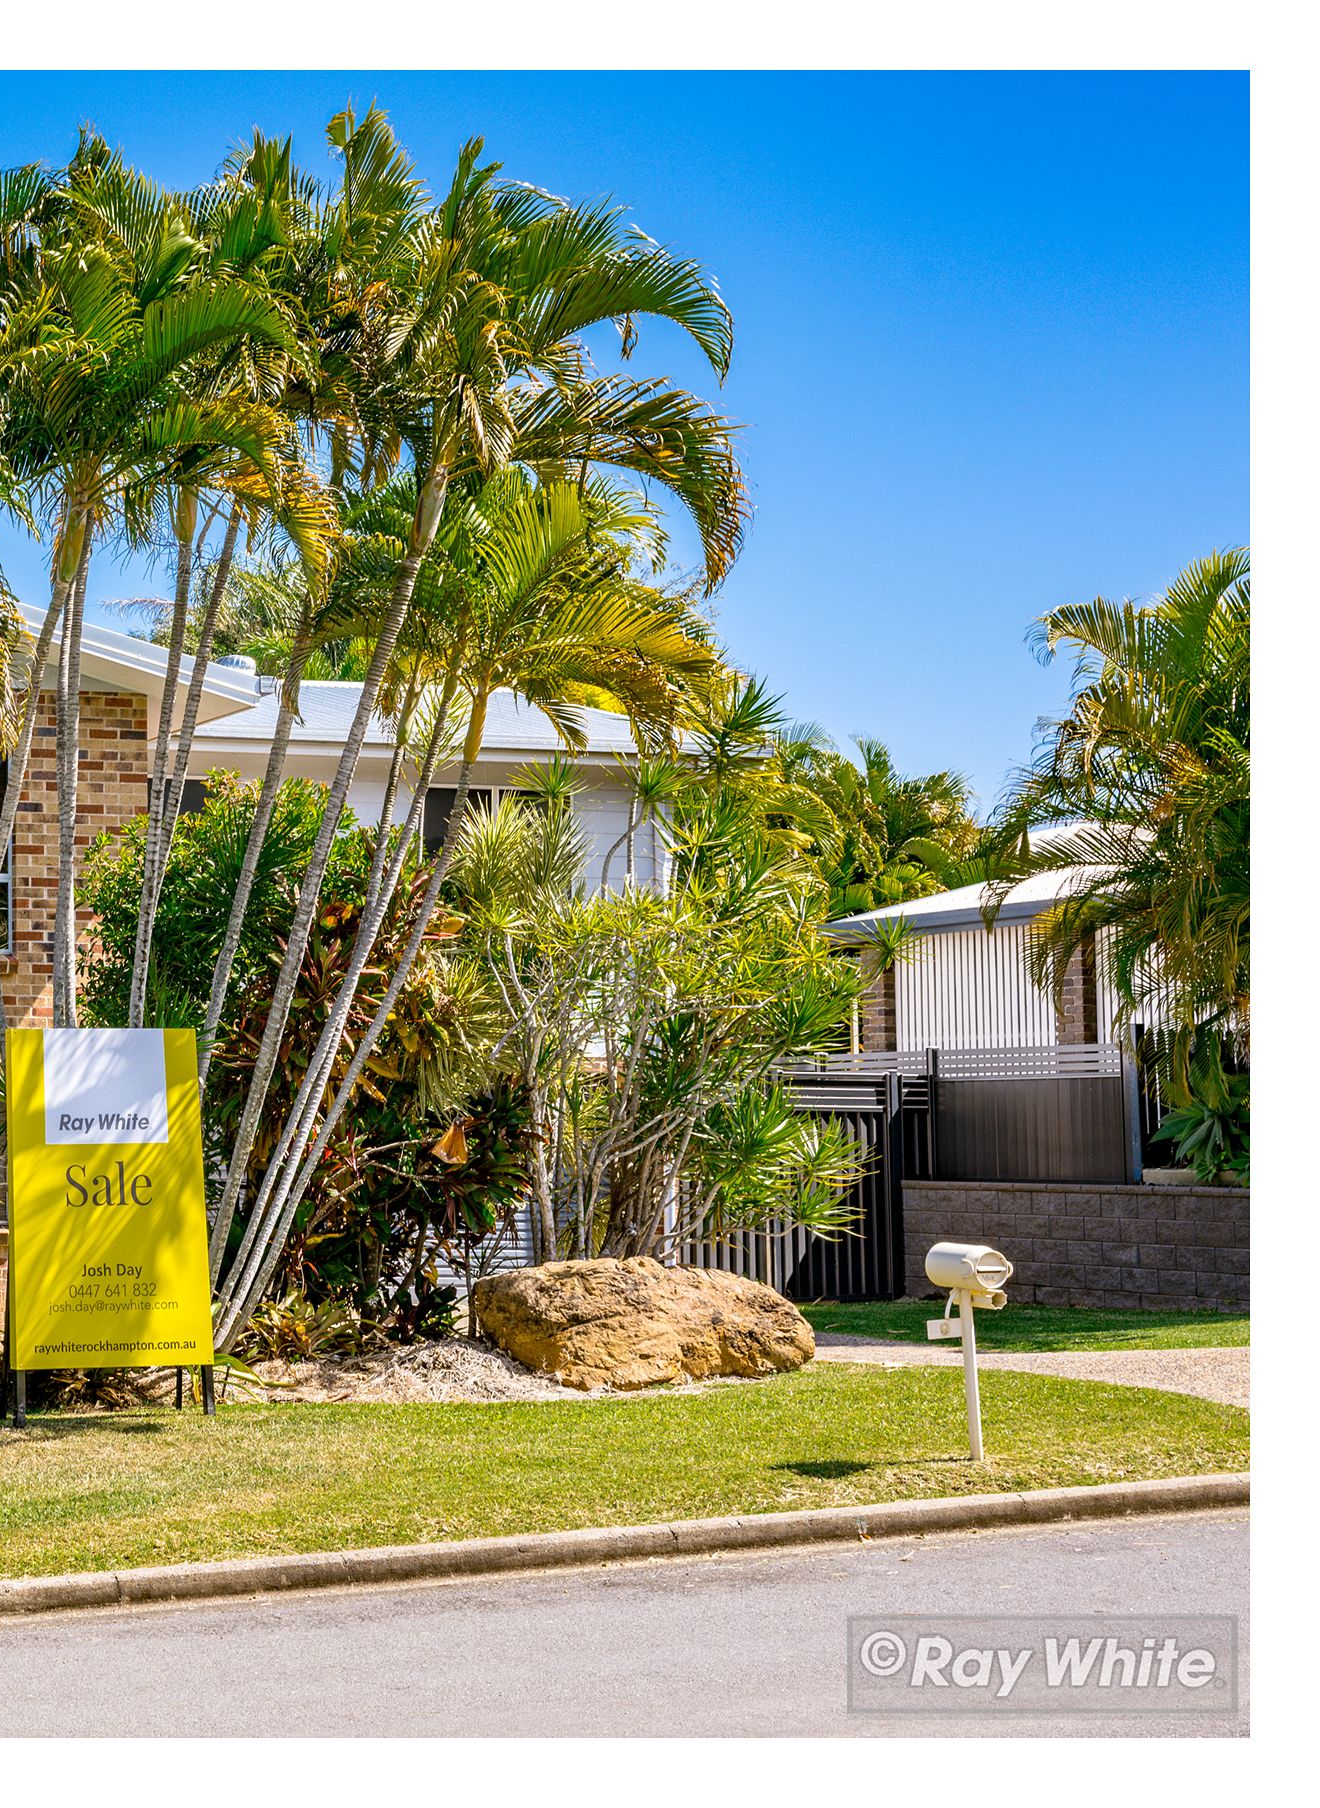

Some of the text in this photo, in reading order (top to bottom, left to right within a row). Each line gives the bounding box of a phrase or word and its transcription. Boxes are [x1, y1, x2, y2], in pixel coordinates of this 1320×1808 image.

[59, 1113, 149, 1133] Ray White
[66, 1160, 153, 1208] Sale
[81, 1263, 142, 1279] Josh Day
[69, 1283, 157, 1298] 0447 641 832
[48, 1299, 179, 1315] josh.day@raywhite.com
[34, 1340, 196, 1354] raywhiterockhampton.com.au
